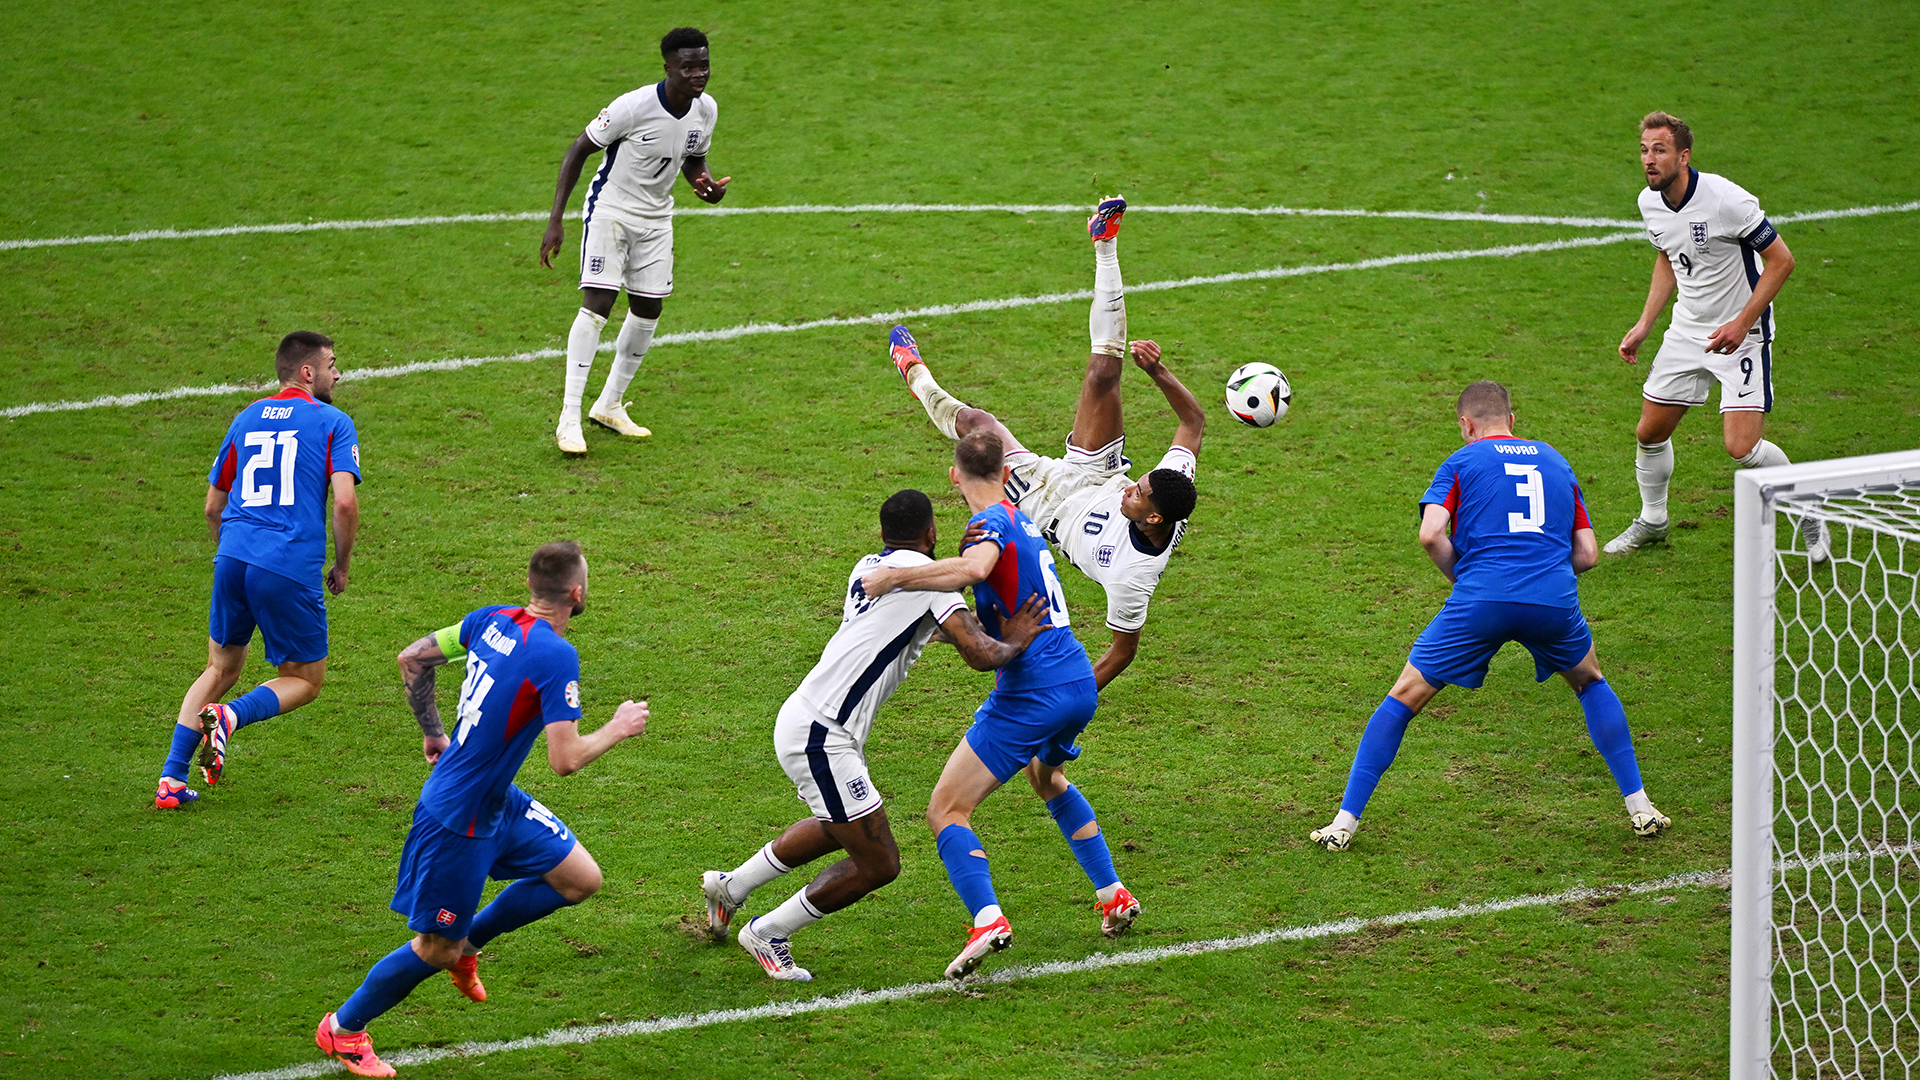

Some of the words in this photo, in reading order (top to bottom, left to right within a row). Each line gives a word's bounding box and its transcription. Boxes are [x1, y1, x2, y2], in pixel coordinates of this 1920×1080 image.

[654, 157, 672, 178] 7
[1679, 252, 1692, 276] 9
[1740, 357, 1753, 386] 9
[241, 430, 299, 507] 21
[1504, 463, 1545, 533] 3
[1084, 511, 1110, 536] 10
[1039, 549, 1070, 628] 6
[457, 650, 495, 746] 14
